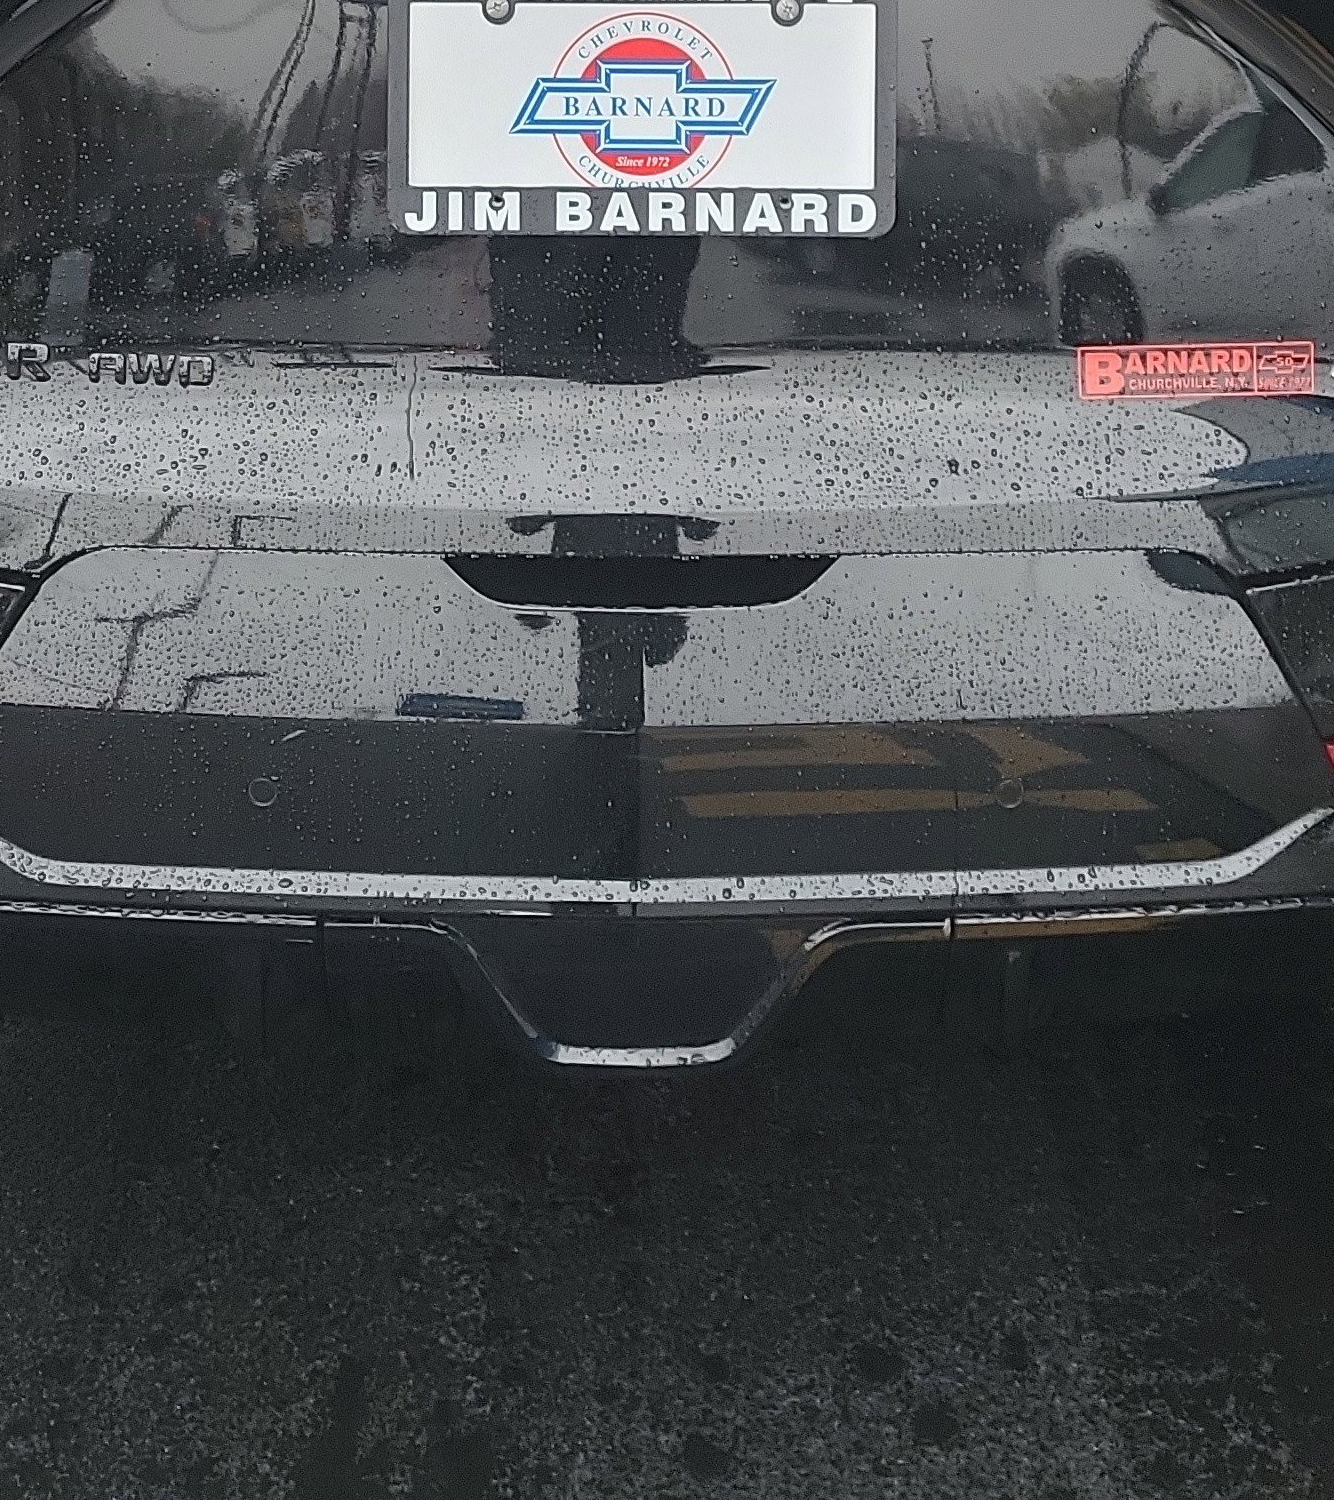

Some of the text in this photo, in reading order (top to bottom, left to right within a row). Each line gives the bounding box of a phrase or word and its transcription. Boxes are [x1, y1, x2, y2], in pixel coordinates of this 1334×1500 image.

[578, 19, 714, 60] CHEVROLET
[563, 96, 727, 118] BARNARD
[615, 156, 671, 168] Since 1972
[404, 191, 879, 235] JIM BARNARD
[88, 352, 215, 386] AWD
[1084, 349, 1253, 395] BARNARD
